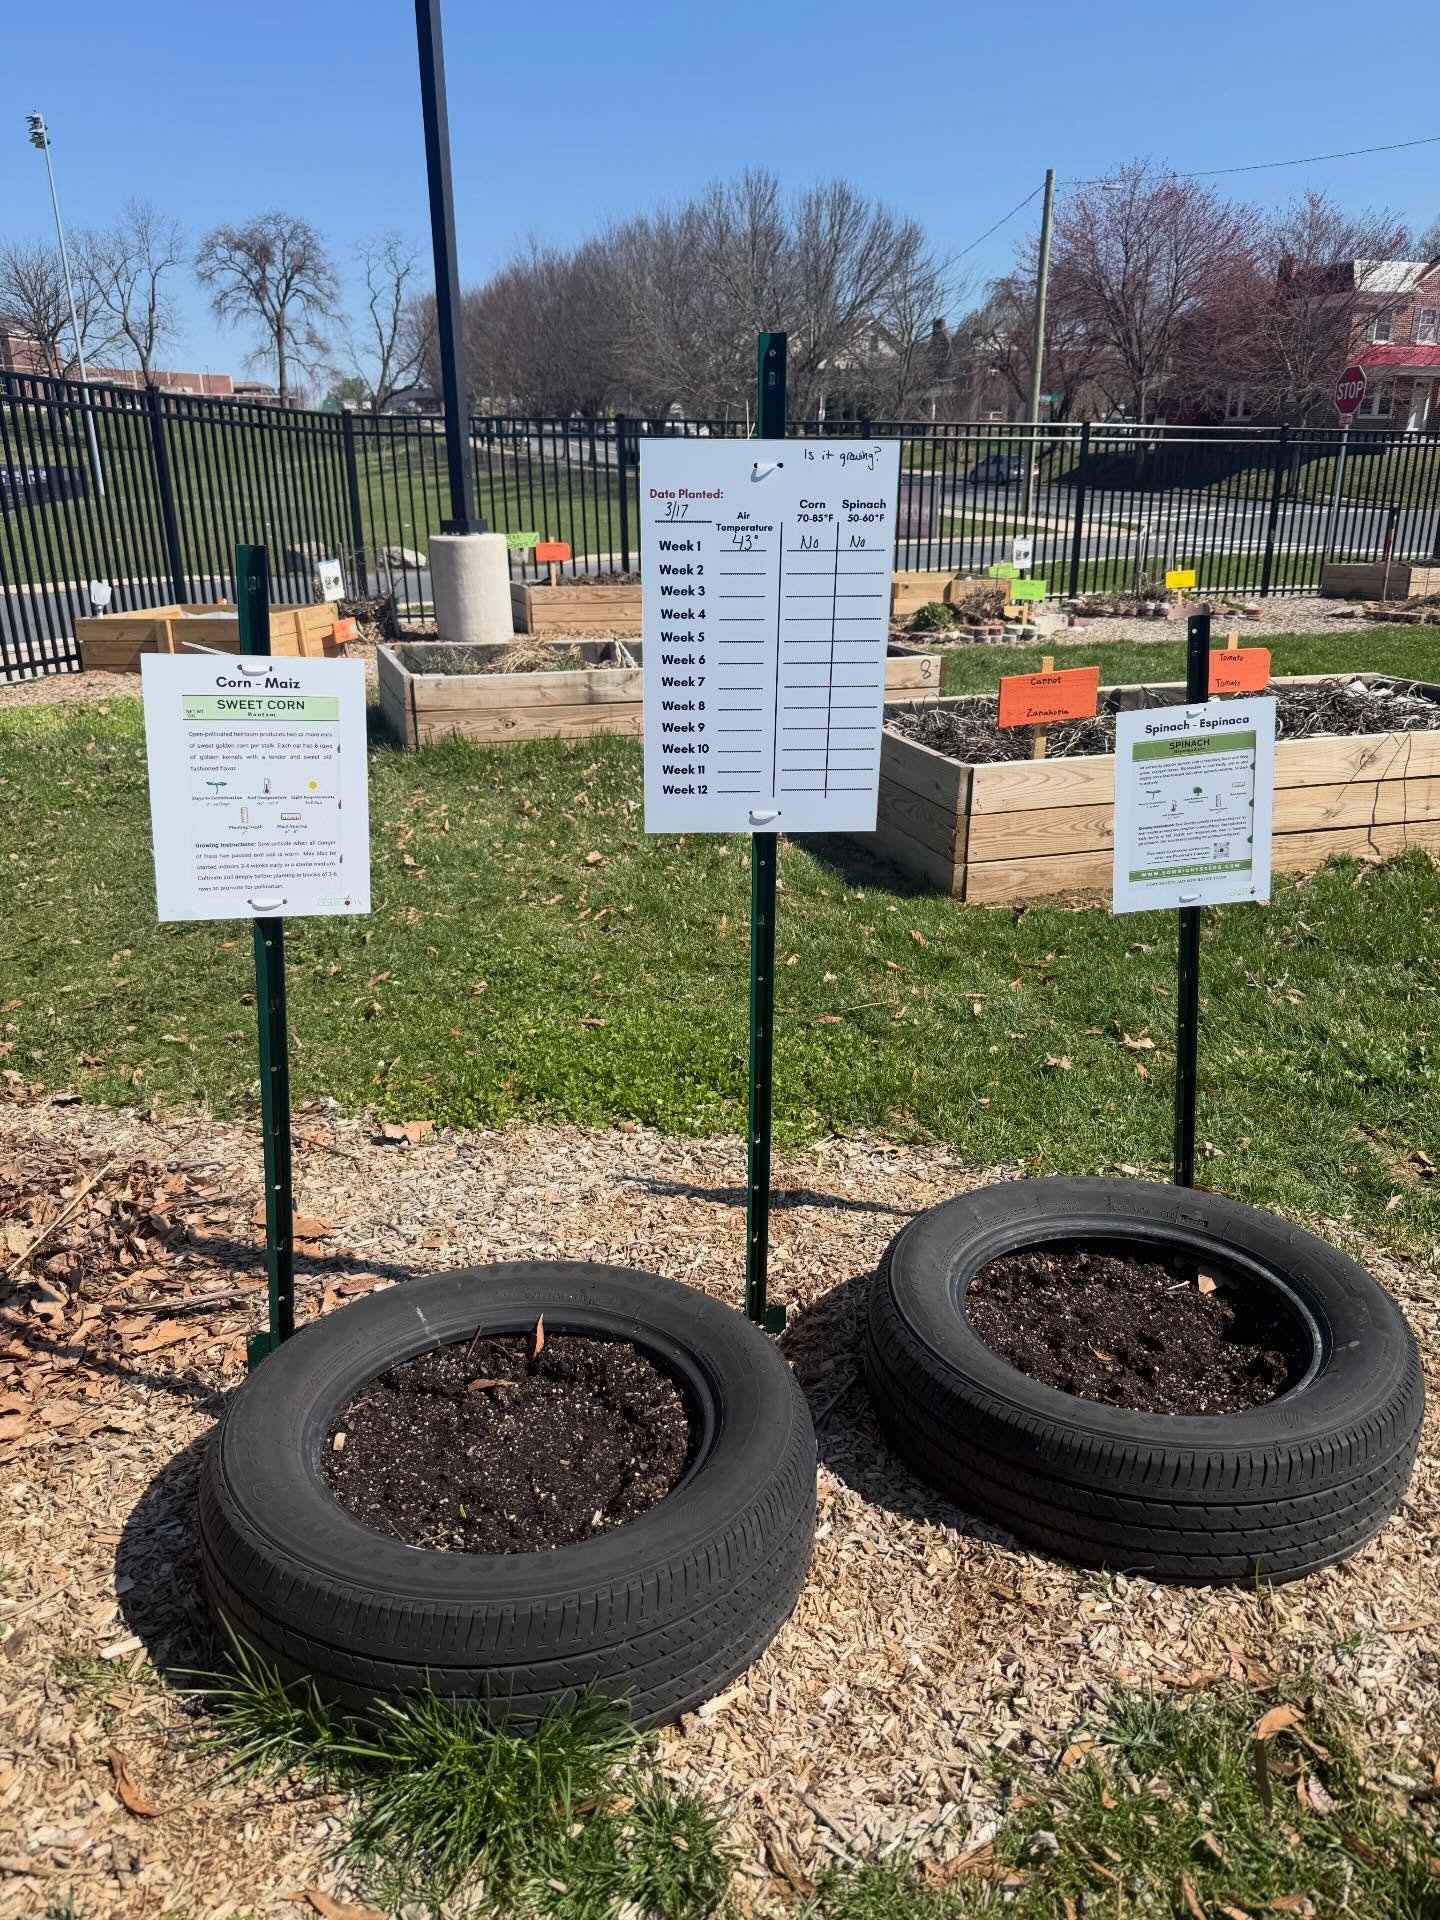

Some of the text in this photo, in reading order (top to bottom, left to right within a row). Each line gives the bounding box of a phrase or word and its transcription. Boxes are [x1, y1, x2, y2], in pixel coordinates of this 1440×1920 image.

[1337, 380, 1364, 401] STOP
[804, 446, 882, 470] Is it growing?
[650, 489, 724, 499] Date Planted:
[800, 499, 887, 511] Corn Spinach
[664, 502, 689, 521] 3/17
[737, 511, 750, 520] Air
[716, 523, 773, 533] Temperature
[659, 540, 701, 551] Week 1
[800, 535, 819, 549] No
[849, 535, 866, 548] No
[659, 565, 704, 575] Week 2
[661, 585, 705, 596] Week 3
[661, 609, 706, 620] Week 4
[661, 631, 705, 642] Week 5
[661, 654, 706, 665] Week 6
[1219, 653, 1244, 662] Tomato
[919, 659, 932, 680] 8
[216, 676, 252, 688] Corn
[265, 677, 301, 689] Maiz
[661, 676, 706, 687] Week 7
[1030, 676, 1062, 686] Carrot
[217, 699, 305, 710] SWEET CORN
[662, 701, 706, 711] Week 8
[1026, 707, 1070, 717] Zanahoria
[662, 722, 706, 732] Week 9
[1145, 720, 1190, 736] Spinach
[1199, 716, 1250, 730] Espinaca
[662, 743, 709, 754] Week 10
[1169, 738, 1210, 750] SPINACH
[662, 764, 705, 774] Week 11
[662, 784, 708, 795] Week 12
